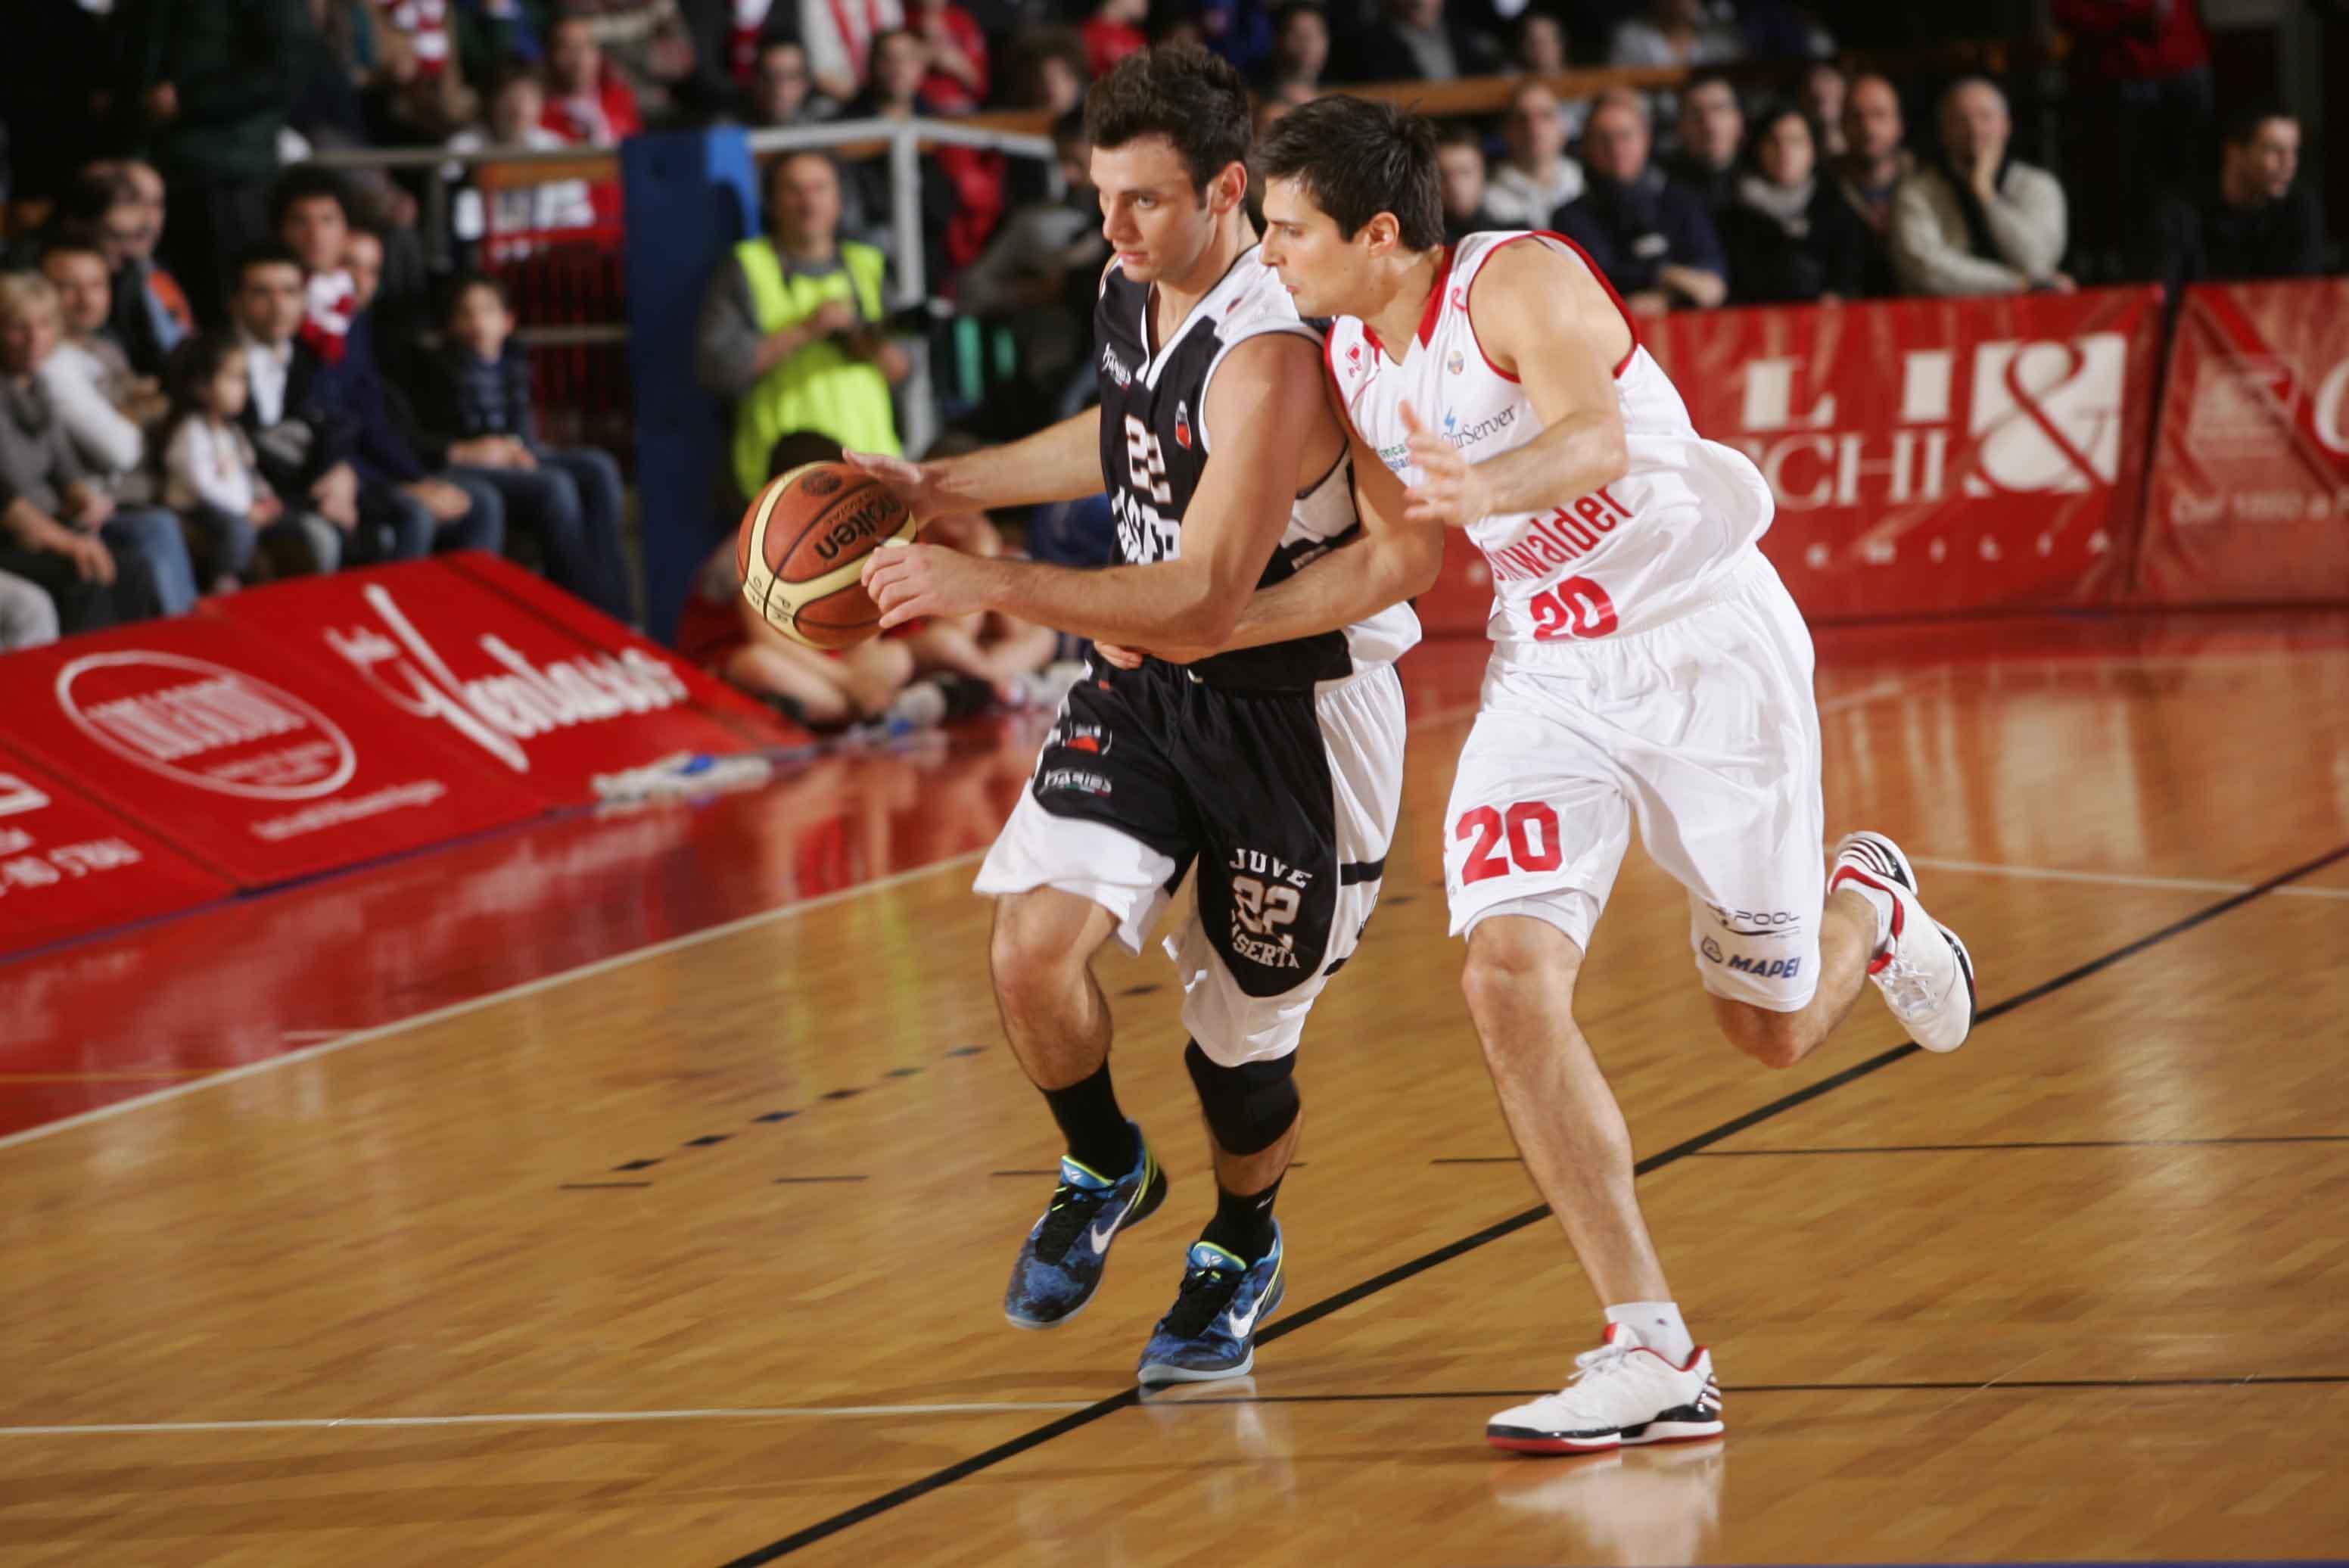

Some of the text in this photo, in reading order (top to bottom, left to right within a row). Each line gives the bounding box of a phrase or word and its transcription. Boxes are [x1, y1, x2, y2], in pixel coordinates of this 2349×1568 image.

[1492, 484, 1634, 581] kwalder
[1529, 575, 1619, 642] 20
[1229, 848, 1314, 889] JUVE
[1455, 801, 1563, 887] 20
[1231, 908, 1301, 969] SERTA
[1233, 875, 1302, 950] 22
[1728, 954, 1802, 978] MAPEI
